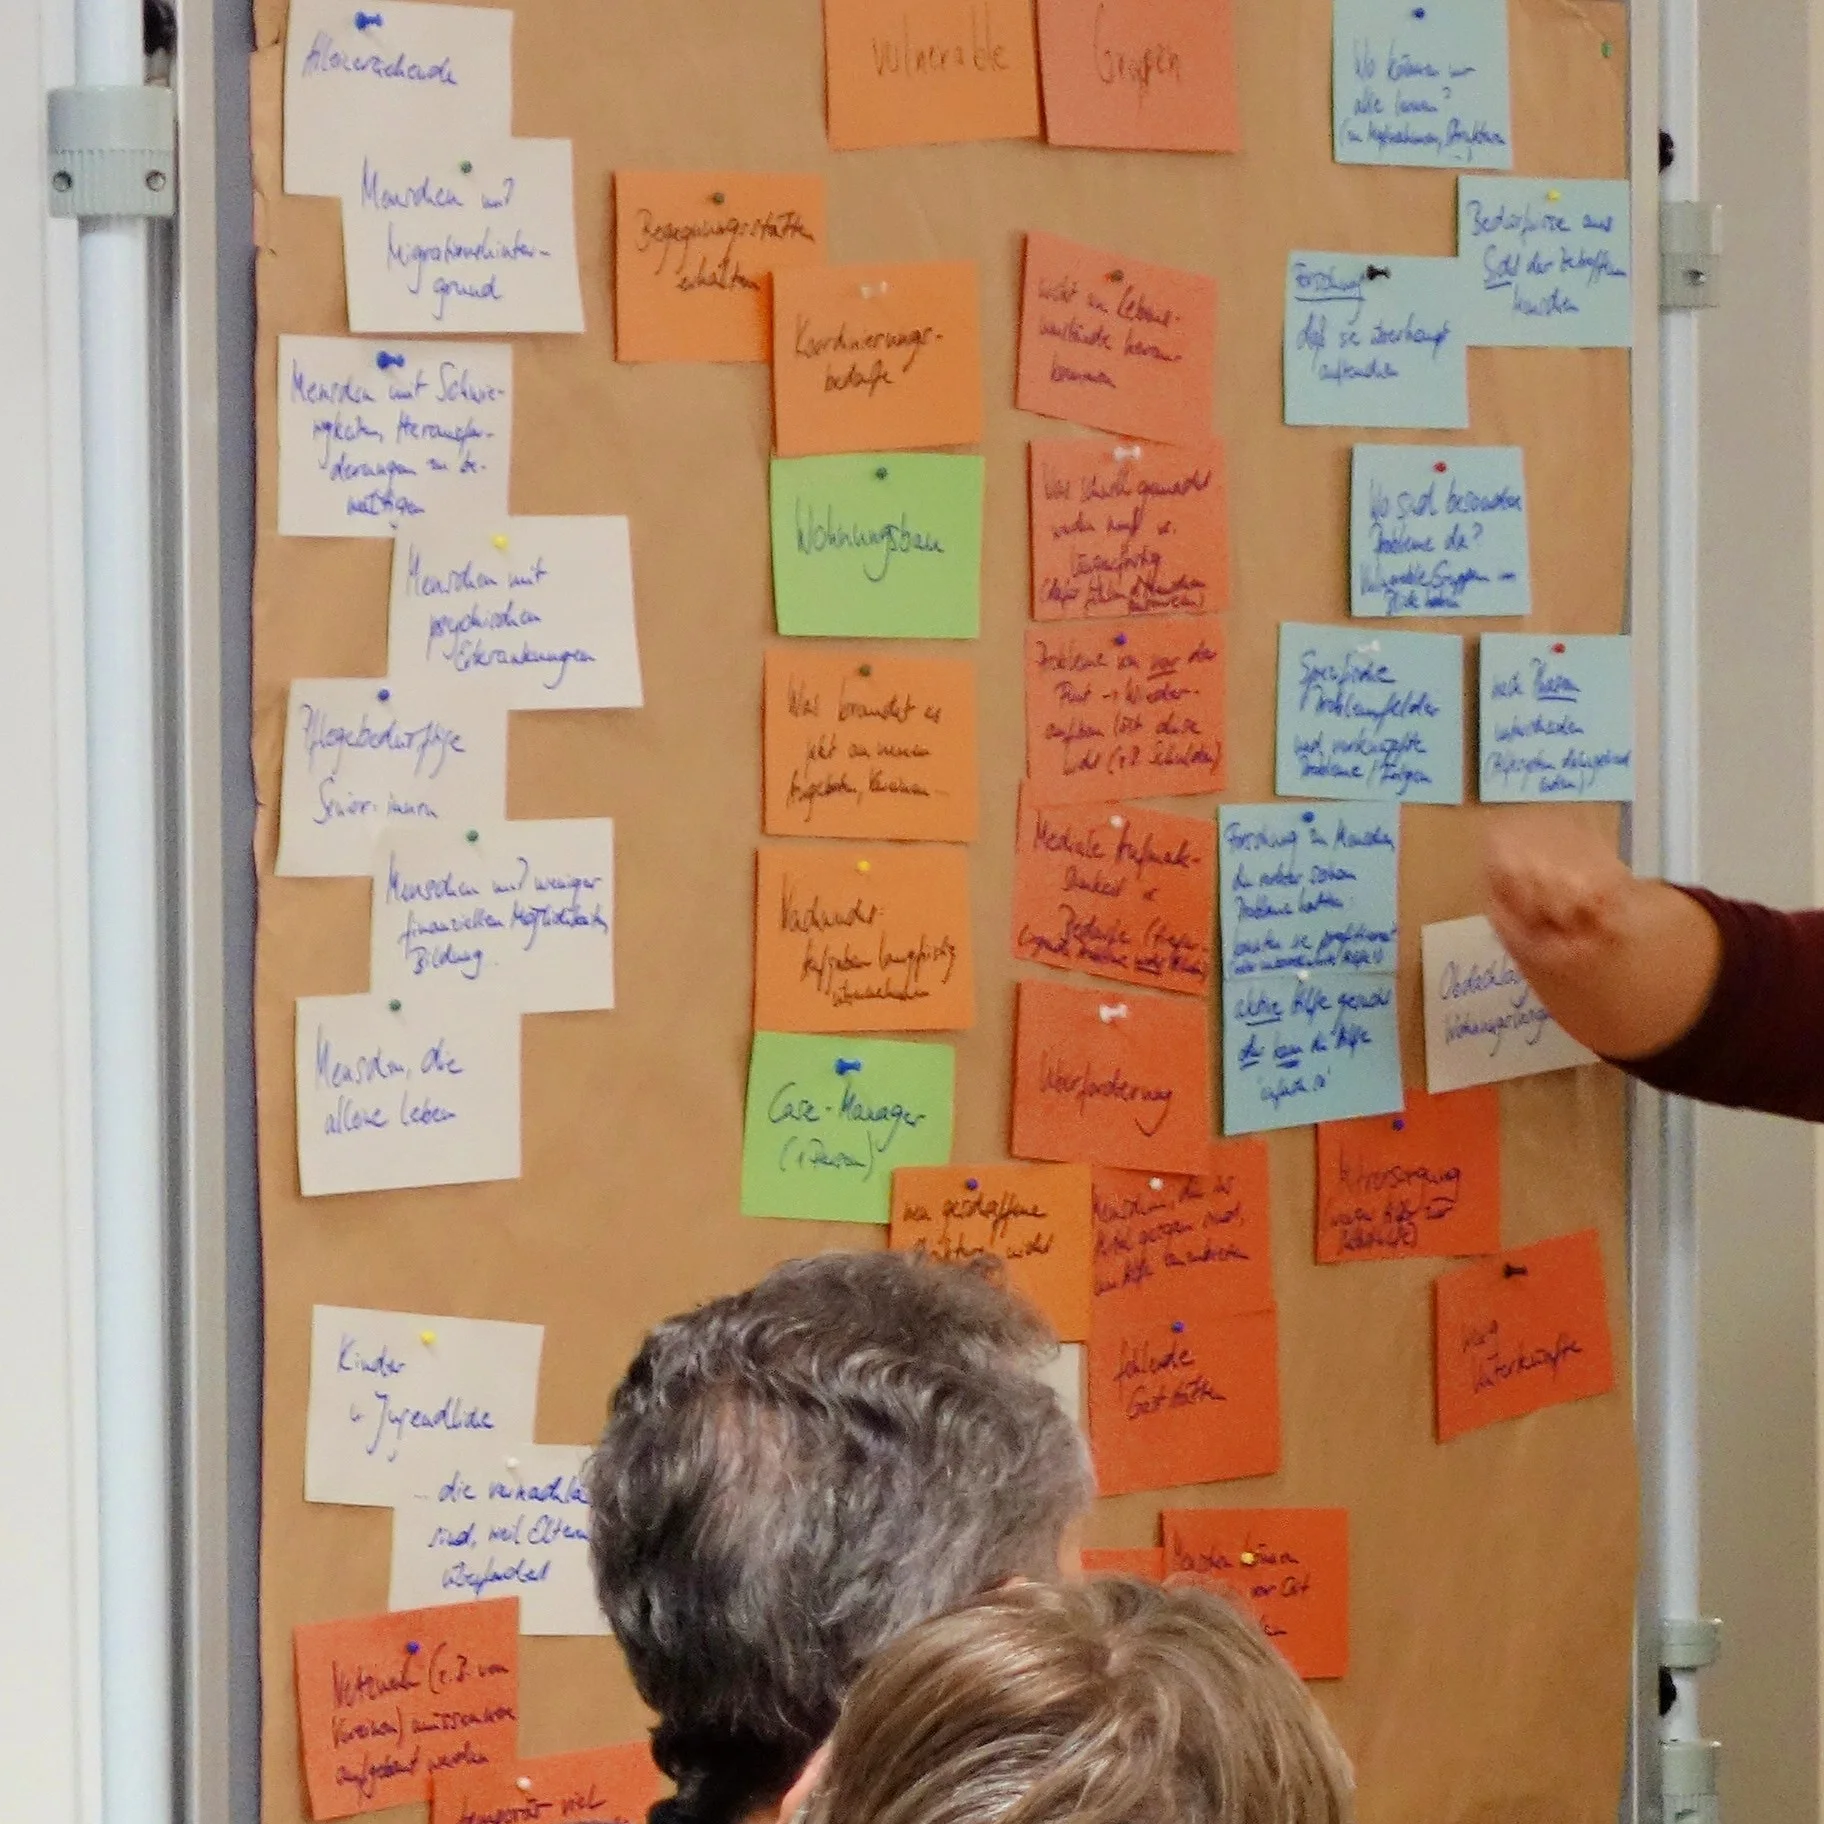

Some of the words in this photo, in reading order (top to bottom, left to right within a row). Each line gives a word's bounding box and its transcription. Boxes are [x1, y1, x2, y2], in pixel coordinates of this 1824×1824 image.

[795, 497, 945, 582] Wohnungsbau
[406, 543, 497, 596] Menschen
[508, 557, 548, 588] mit
[386, 851, 479, 903] Menschen
[420, 1037, 465, 1076] die
[400, 1089, 457, 1127] leben
[337, 1332, 406, 1377] Kinder
